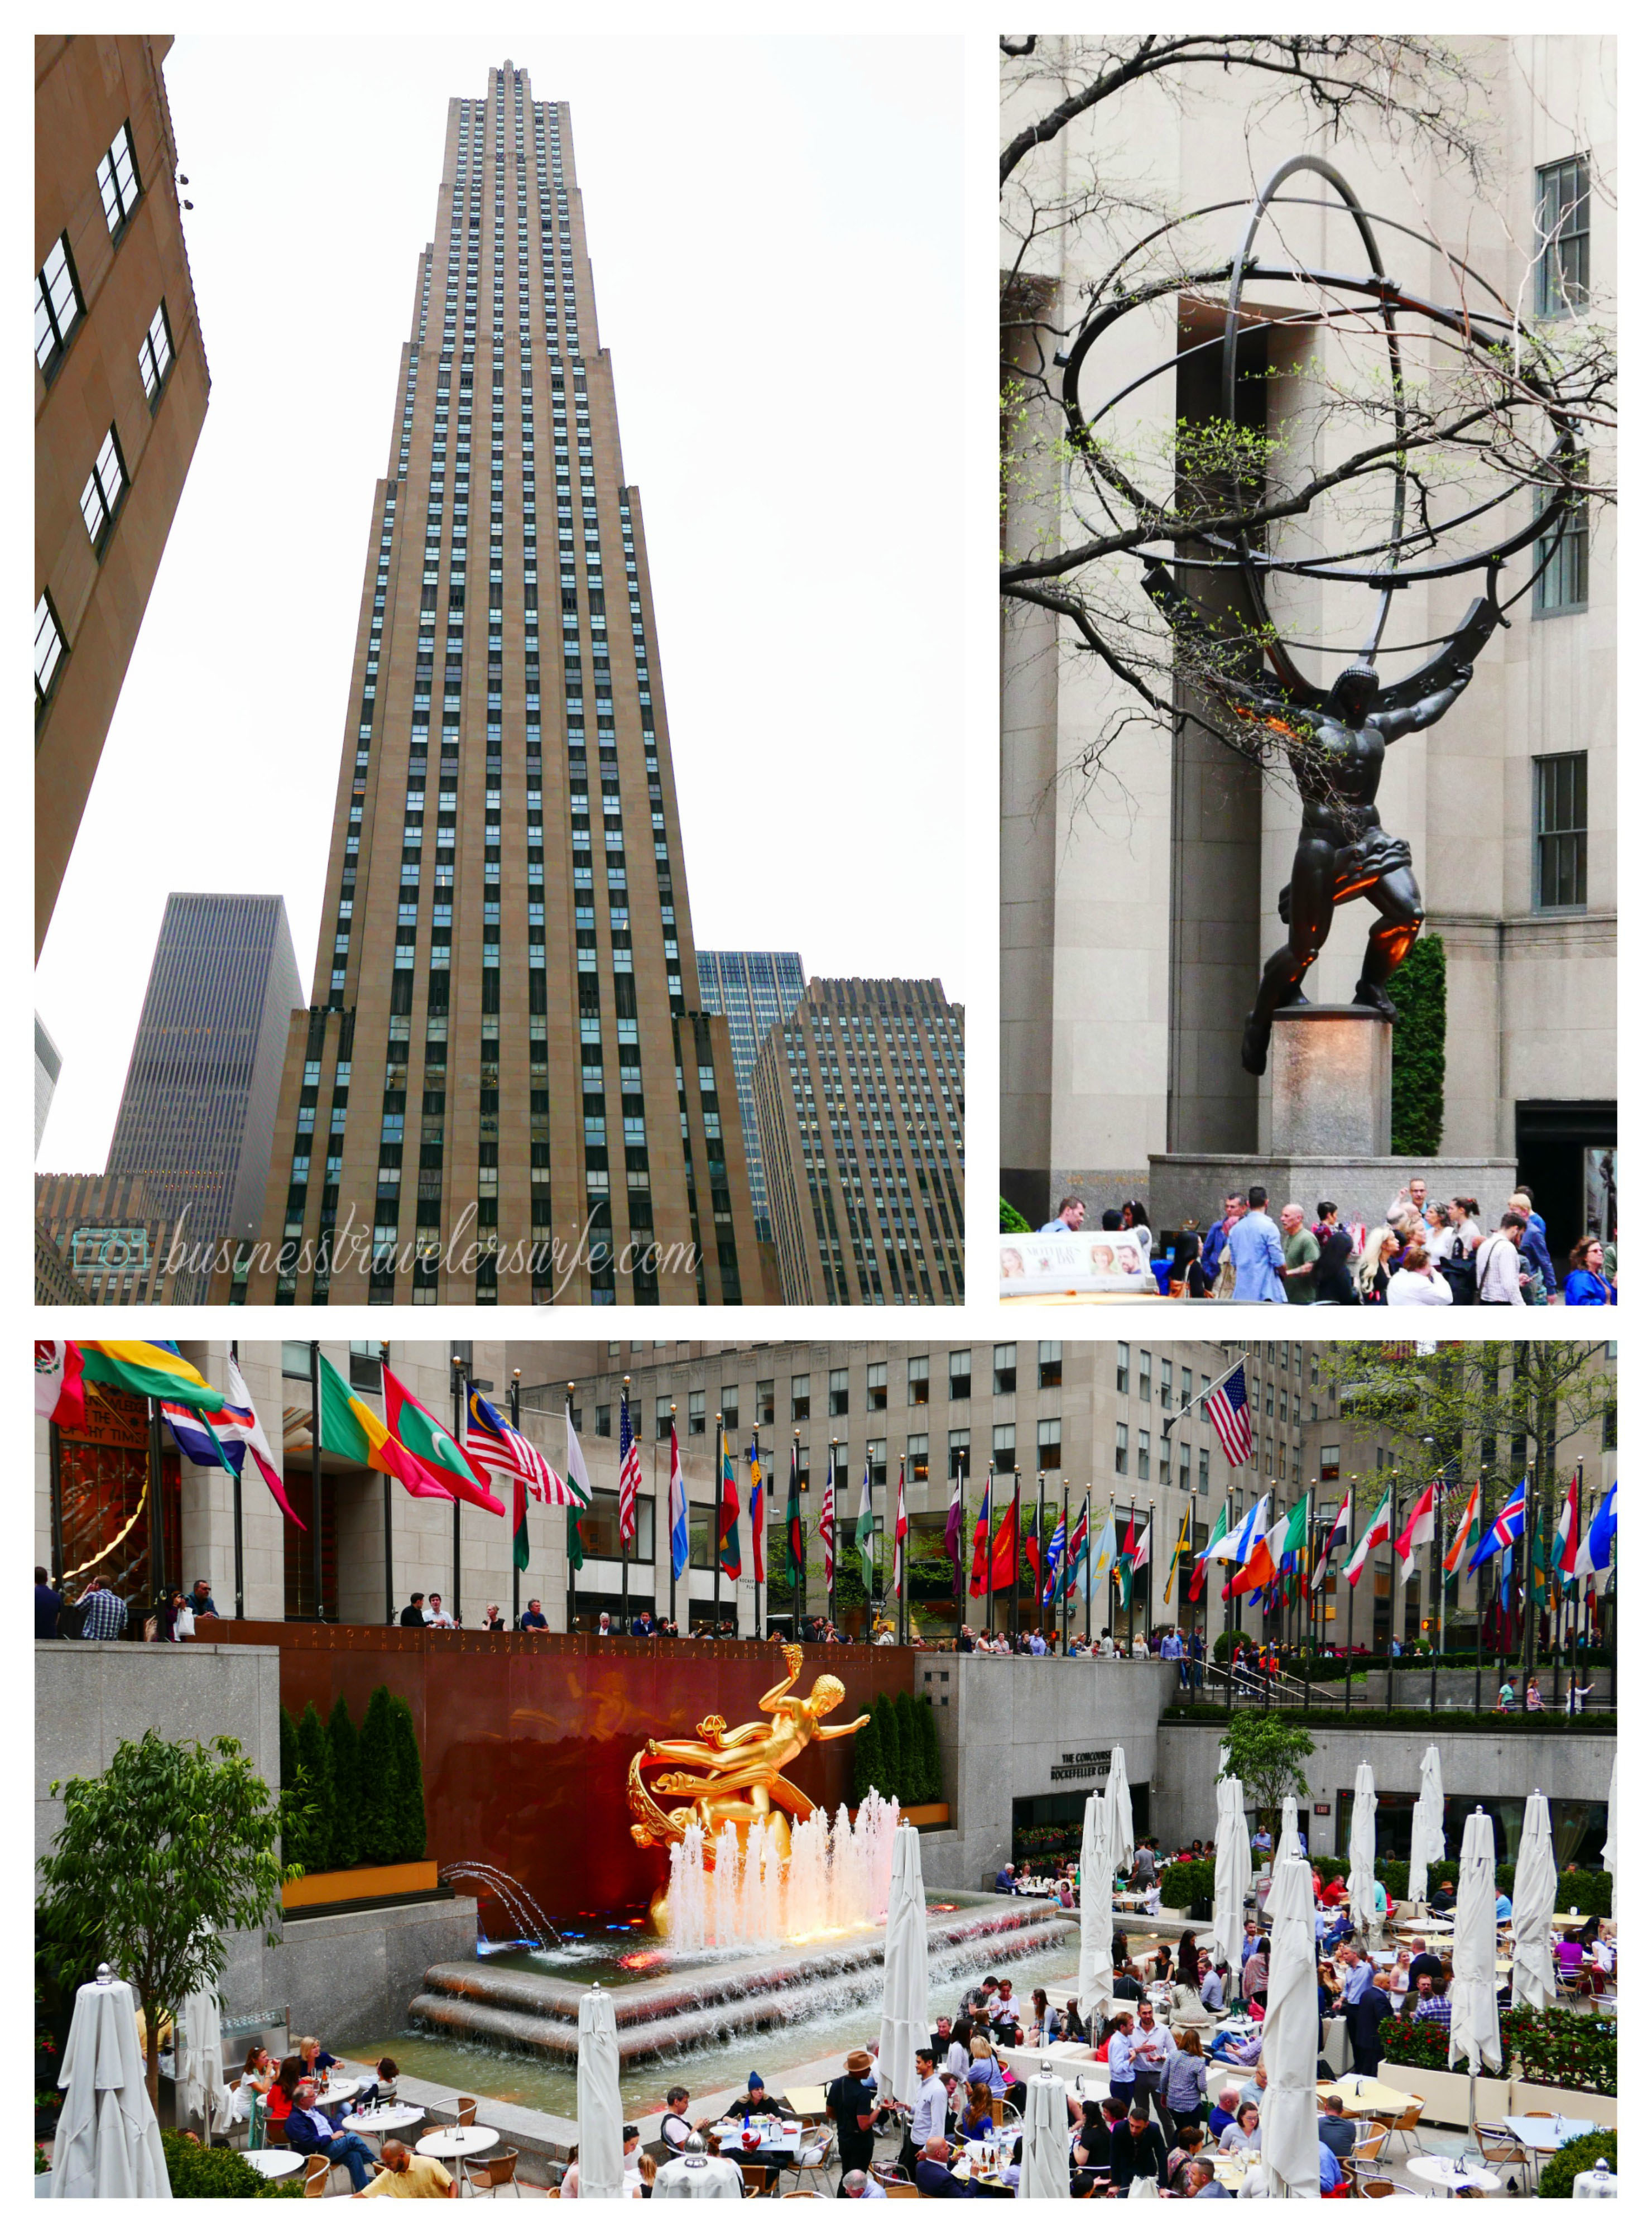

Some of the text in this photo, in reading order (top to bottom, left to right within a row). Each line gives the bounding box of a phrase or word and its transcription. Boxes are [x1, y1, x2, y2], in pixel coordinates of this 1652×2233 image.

[92, 1410, 111, 1424] THE
[312, 1627, 465, 1641] PROMETHEUS
[491, 1634, 577, 1645] TEACHER
[294, 1639, 352, 1650] THAT
[382, 1642, 435, 1652] HATH
[461, 1645, 537, 1654] PROVED
[598, 1649, 674, 1657] MORTALS
[1062, 1750, 1112, 1764] THE CONCOURSE
[1051, 1765, 1111, 1780] ROCKEFELLER CEN
